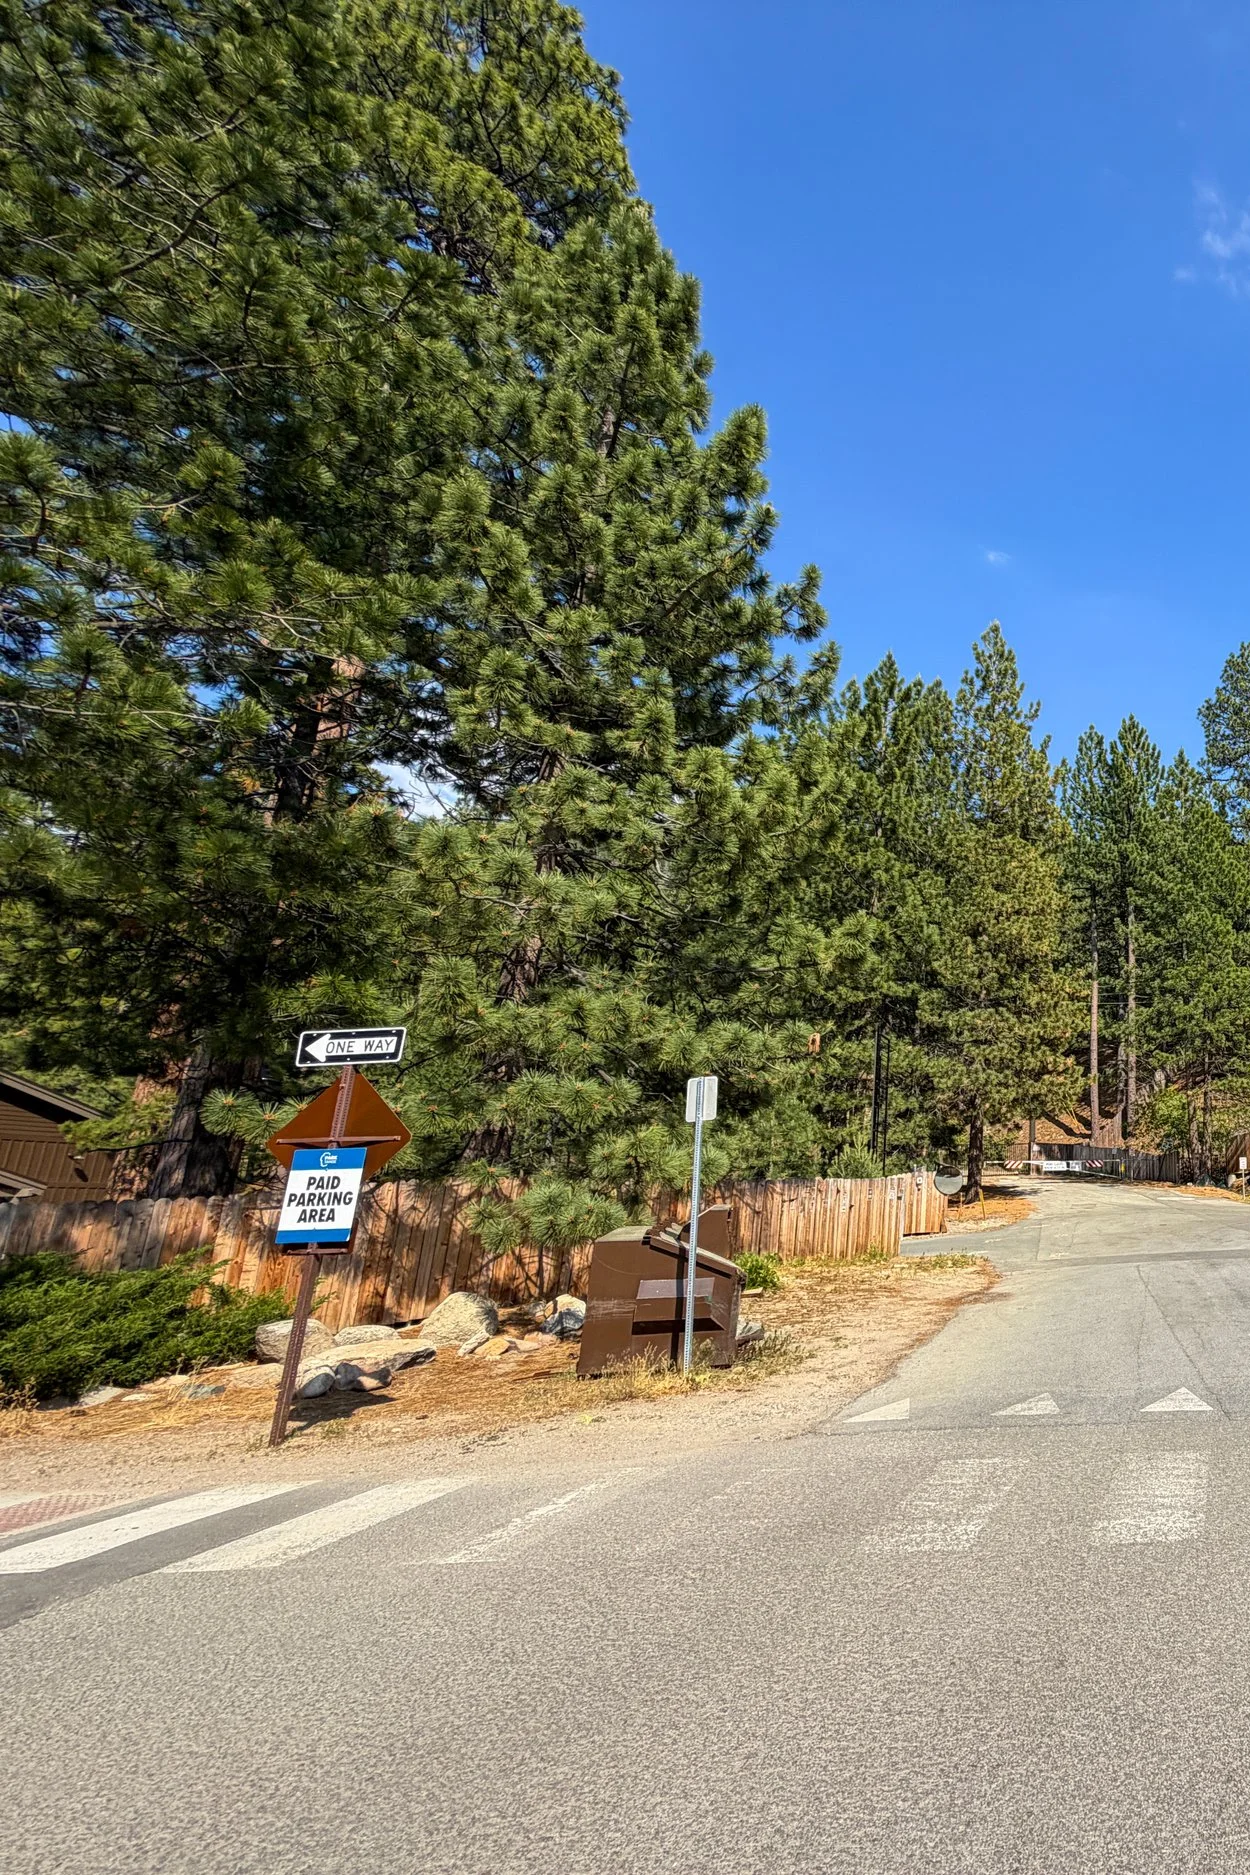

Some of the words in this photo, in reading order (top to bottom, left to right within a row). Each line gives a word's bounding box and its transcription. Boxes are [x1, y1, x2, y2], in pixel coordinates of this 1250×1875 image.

[326, 1041, 355, 1054] ONE
[364, 1039, 395, 1052] WAY
[306, 1176, 341, 1191] PAID
[287, 1191, 354, 1207] PARKING
[296, 1208, 336, 1223] AREA
